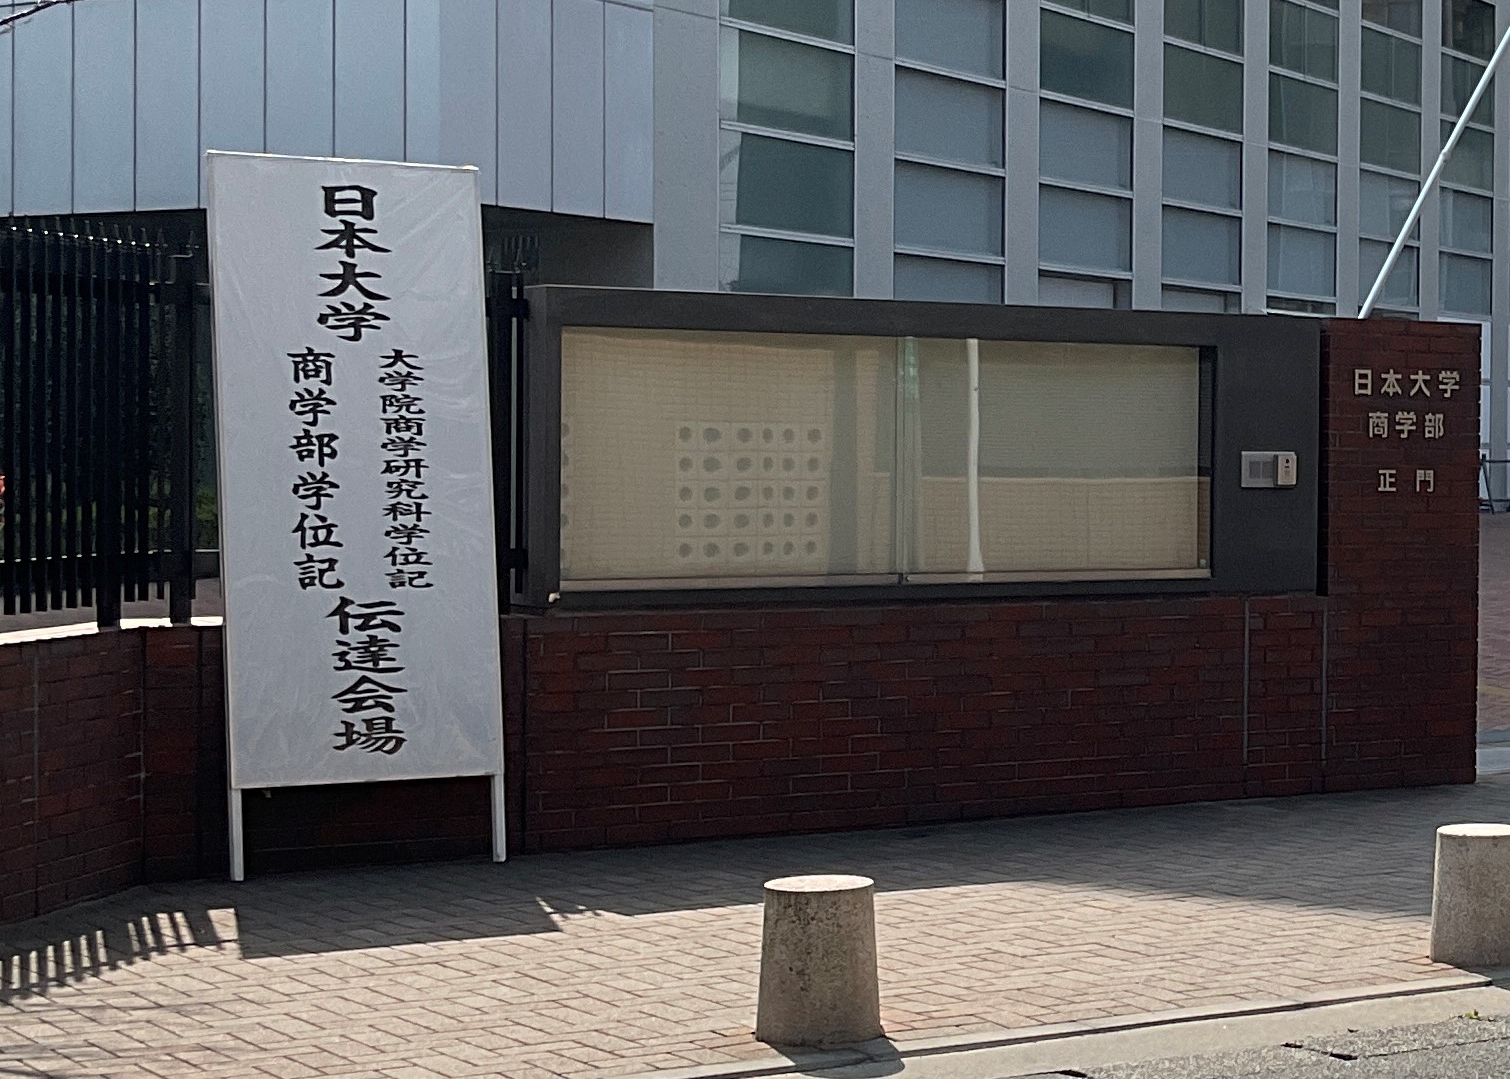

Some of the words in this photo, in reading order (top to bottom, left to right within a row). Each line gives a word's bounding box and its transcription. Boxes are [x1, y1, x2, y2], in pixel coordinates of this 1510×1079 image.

[314, 184, 392, 342] 日本大学
[1354, 368, 1460, 398] 日本大学
[1368, 411, 1445, 439] 商学部
[286, 346, 345, 591] 商学部学位記
[378, 348, 434, 589] 大学院商学研究科学位記
[324, 595, 408, 756] 伝達会場
